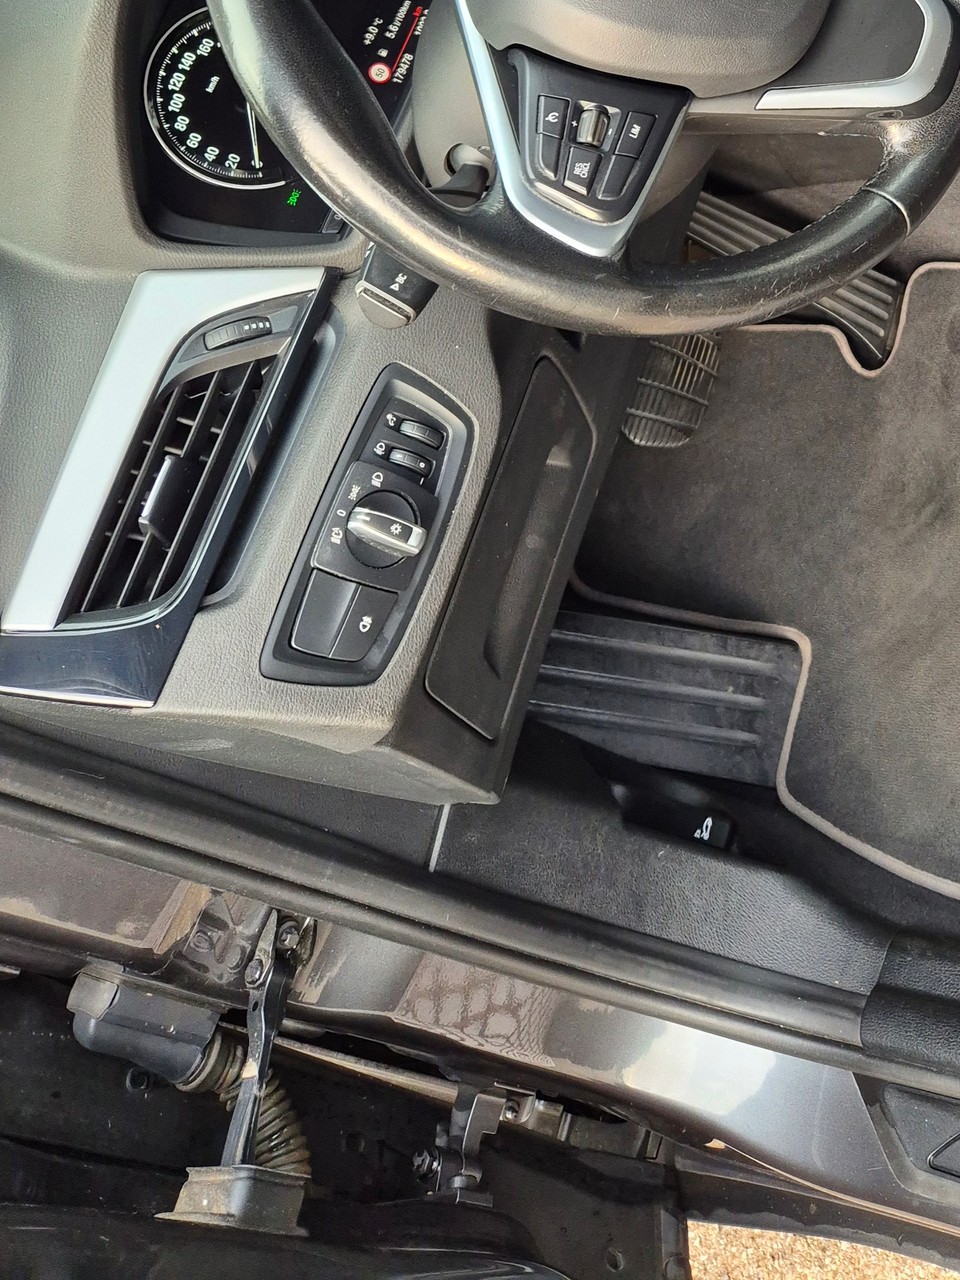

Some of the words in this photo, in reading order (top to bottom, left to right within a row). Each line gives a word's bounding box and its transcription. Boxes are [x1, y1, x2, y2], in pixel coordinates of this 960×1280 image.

[413, 5, 424, 18] km
[363, 25, 379, 46] +9.0
[196, 38, 216, 57] 160
[177, 51, 197, 72] 140
[392, 53, 414, 84] 179478
[376, 67, 386, 78] 50
[167, 72, 186, 92] 120
[205, 75, 221, 94] km/h
[168, 93, 186, 113] 100
[174, 115, 190, 132] 80
[628, 123, 642, 140] LIM
[186, 132, 202, 149] 60
[203, 146, 220, 162] 40
[224, 154, 241, 170] 20
[573, 162, 582, 176] RES
[394, 272, 408, 284] BC
